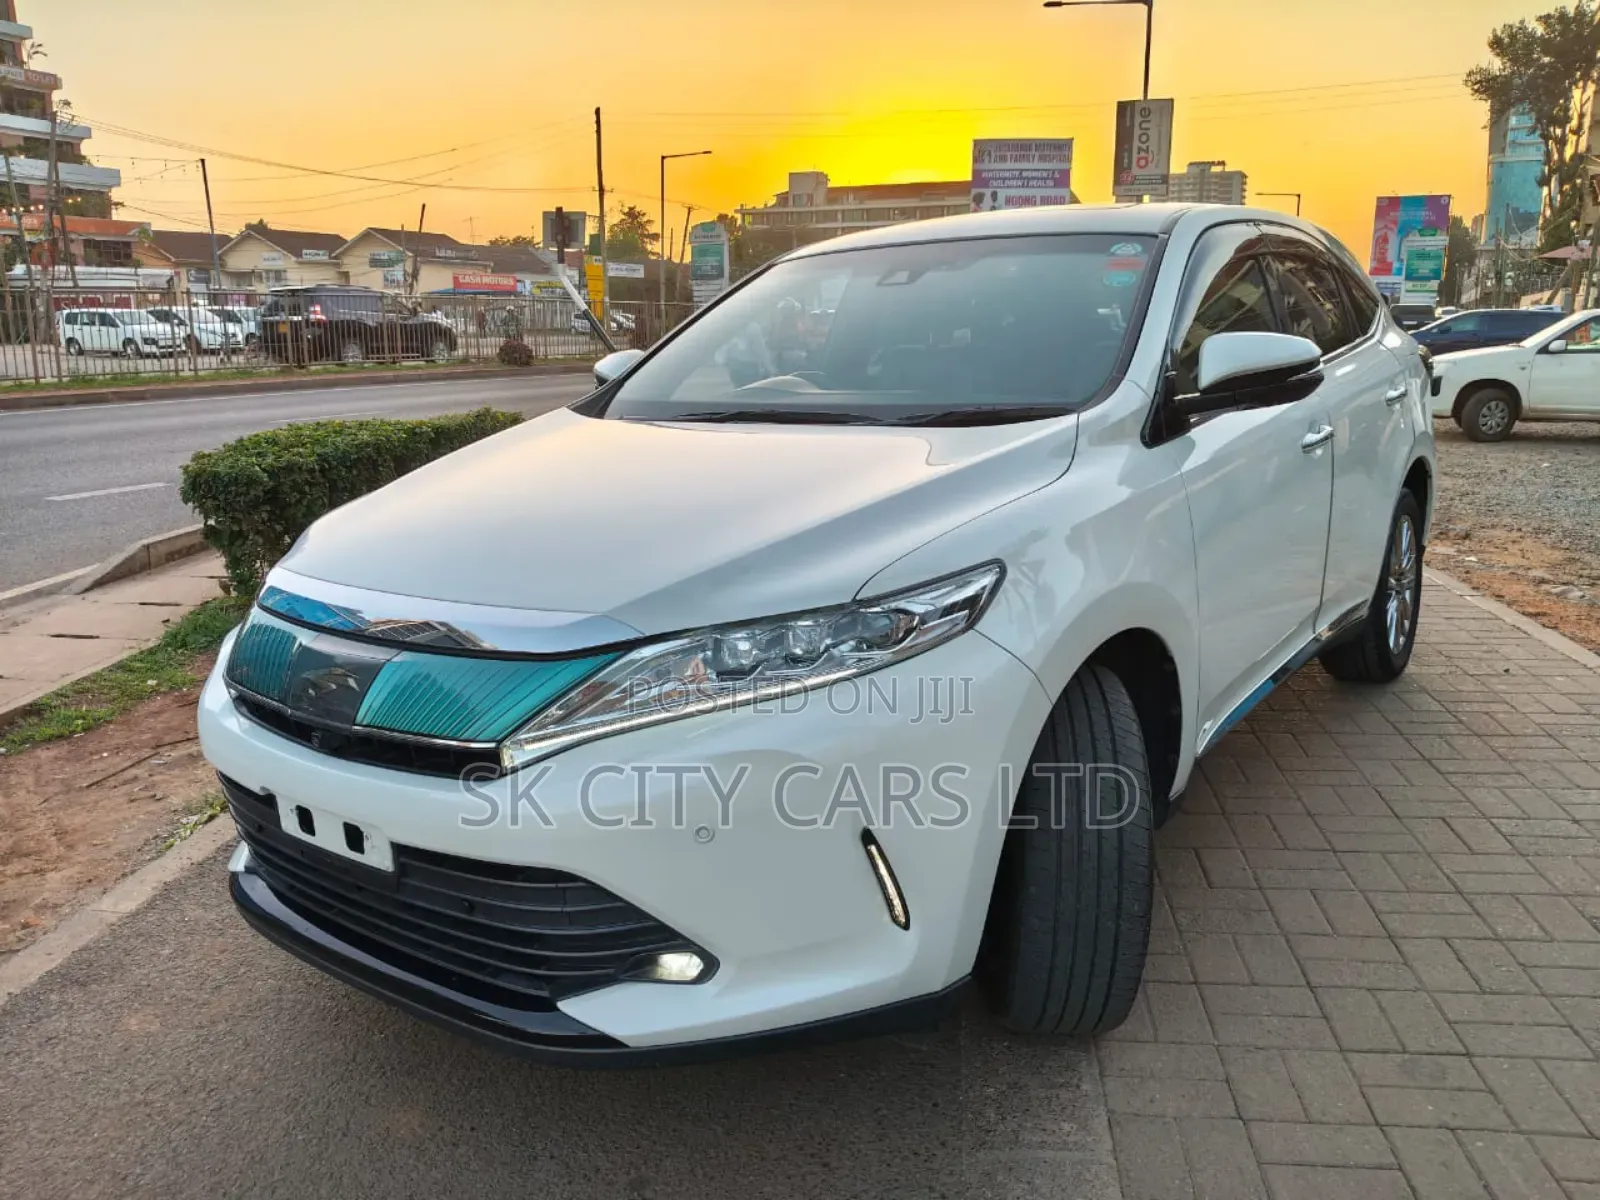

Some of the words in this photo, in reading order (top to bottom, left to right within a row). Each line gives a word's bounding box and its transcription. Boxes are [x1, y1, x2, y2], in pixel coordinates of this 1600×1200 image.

[1136, 106, 1152, 169] azone
[1010, 153, 1036, 163] FAMILY
[482, 276, 515, 286] MOTORS
